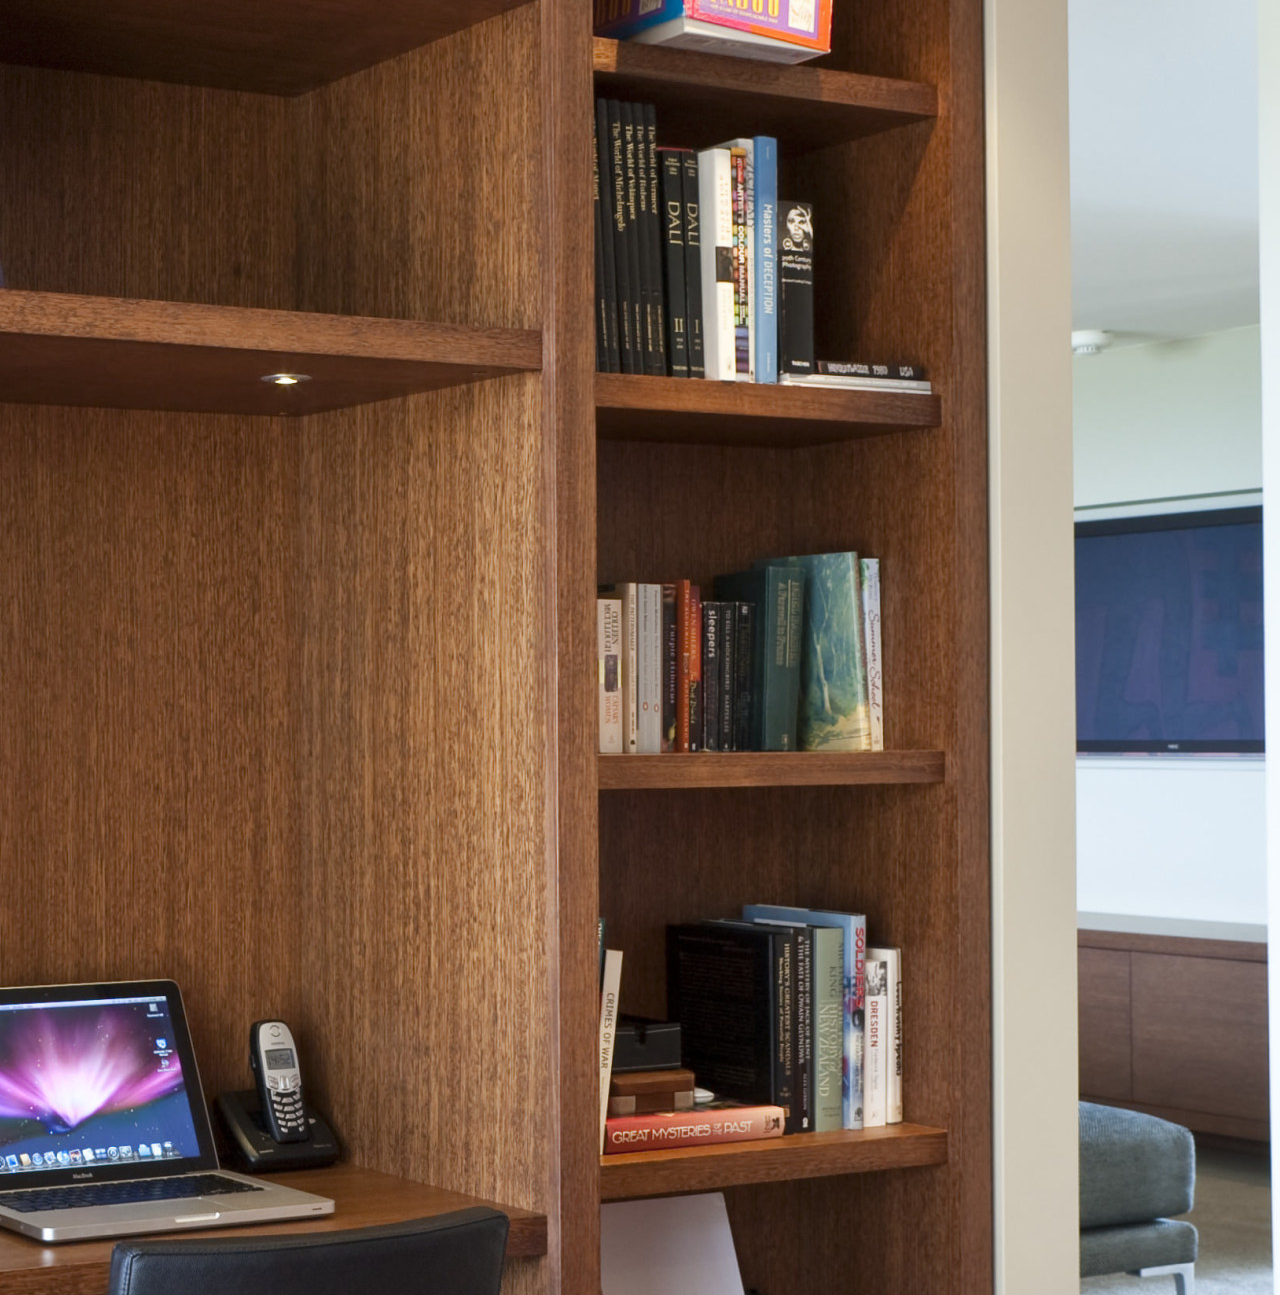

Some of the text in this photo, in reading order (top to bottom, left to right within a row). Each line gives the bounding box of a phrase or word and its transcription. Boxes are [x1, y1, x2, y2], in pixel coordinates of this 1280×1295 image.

[736, 183, 745, 225] ARTIST'S
[738, 264, 746, 305] MANUAL
[762, 203, 774, 314] Masters of DECEPTION
[706, 609, 718, 658] sleepers
[867, 609, 881, 710] Summer School
[829, 966, 837, 998] KING
[854, 927, 865, 1008] SOLDIERS
[601, 992, 615, 1069] CRIMES OF WAR
[819, 1003, 831, 1097] NEW ZEALAND
[870, 1001, 879, 1048] DRESDEN
